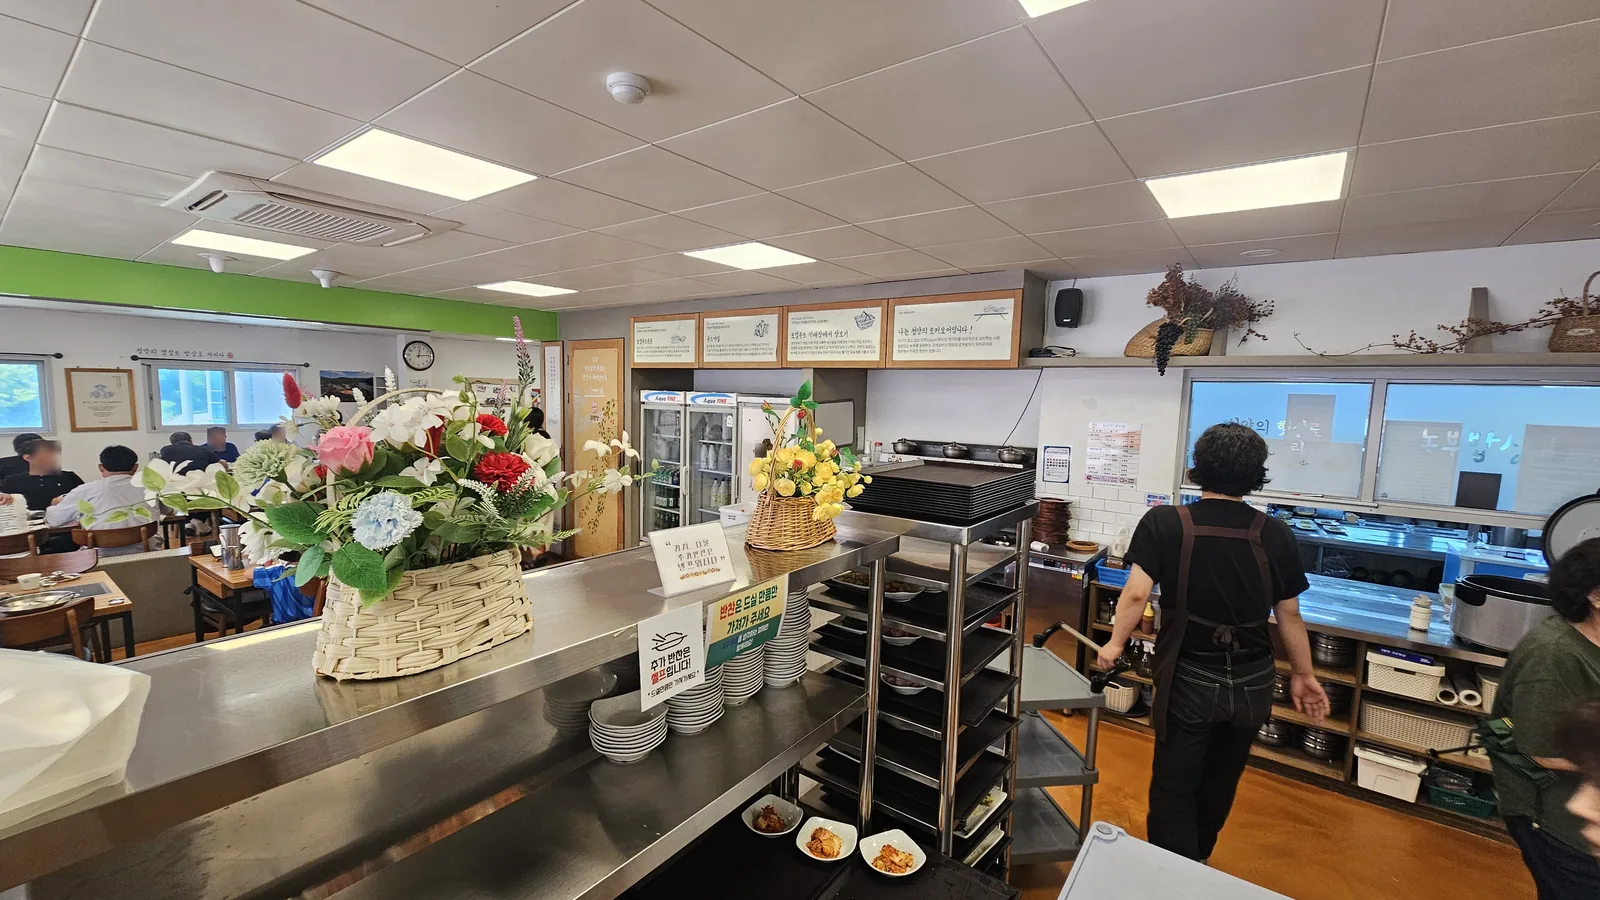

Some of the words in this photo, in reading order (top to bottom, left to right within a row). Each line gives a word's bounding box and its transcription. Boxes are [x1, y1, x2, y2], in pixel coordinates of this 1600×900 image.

[720, 599, 743, 620] 반찬은
[744, 594, 757, 611] 드실
[758, 585, 778, 604] 만큼만
[726, 615, 749, 635] 가져가
[750, 606, 771, 625] 주세요
[650, 658, 691, 685] 셀프입니다!
[651, 655, 666, 672] 추가
[667, 646, 691, 663] 반찬은
